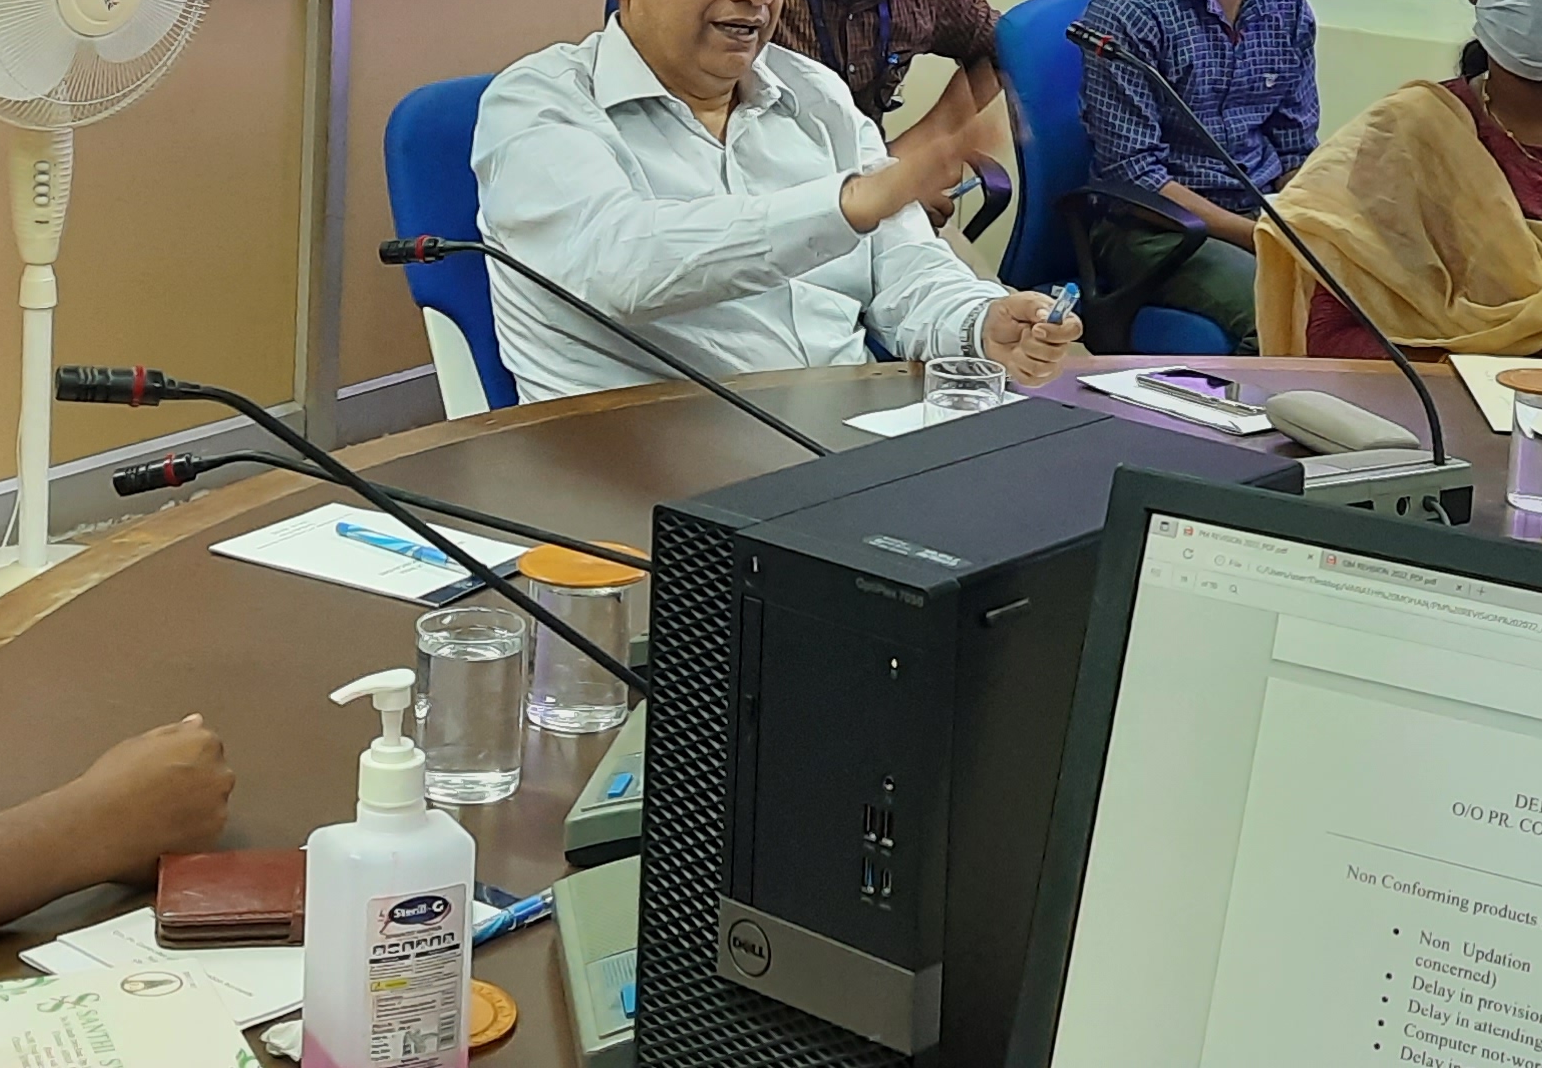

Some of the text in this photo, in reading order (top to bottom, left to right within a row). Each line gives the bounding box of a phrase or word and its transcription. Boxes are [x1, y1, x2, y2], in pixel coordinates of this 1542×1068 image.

[1451, 800, 1484, 822] O/O
[1346, 864, 1377, 886] Non
[1381, 874, 1470, 914] Conforming
[1472, 899, 1538, 927] products
[732, 936, 765, 960] DELL
[1418, 930, 1451, 952] Non
[1462, 941, 1532, 974] Updation
[1414, 955, 1498, 989] concerned)
[1411, 975, 1456, 1005] Delay
[1459, 987, 1474, 1005] in
[1407, 999, 1452, 1026] Delay
[1455, 1012, 1470, 1029] in
[1403, 1022, 1478, 1055] Computer
